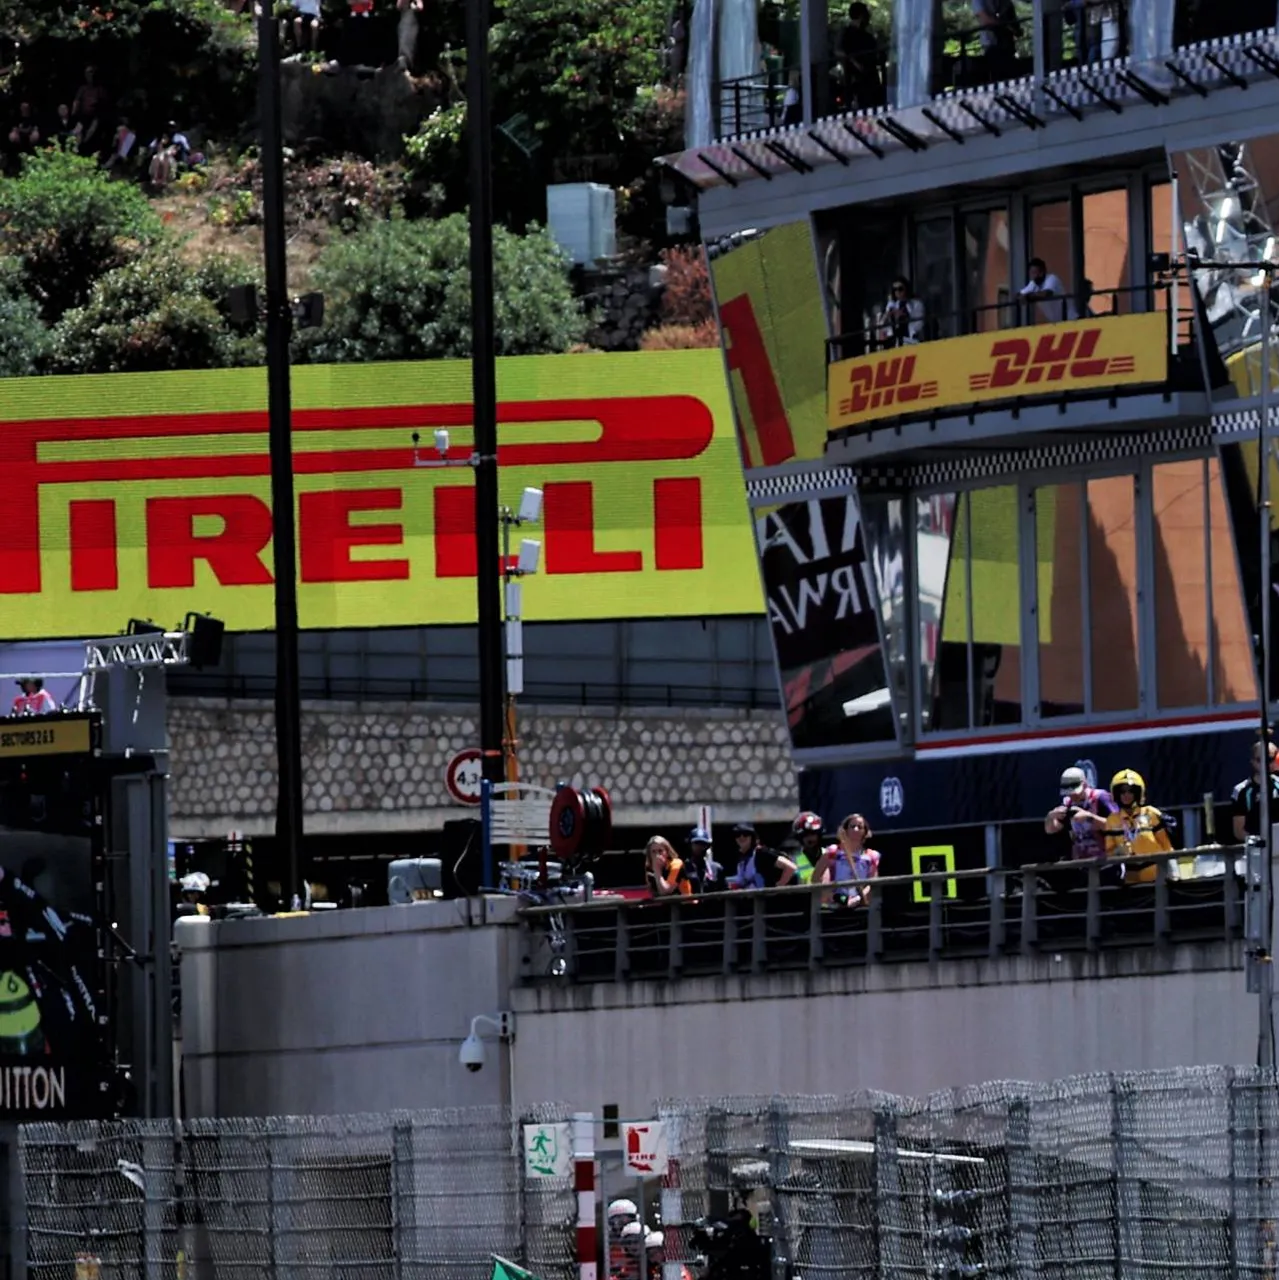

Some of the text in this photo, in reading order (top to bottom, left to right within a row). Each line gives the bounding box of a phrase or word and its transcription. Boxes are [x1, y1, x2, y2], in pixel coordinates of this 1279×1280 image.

[845, 356, 920, 413] DHL
[988, 329, 1110, 388] DHL
[0, 394, 714, 593] PIRELLI
